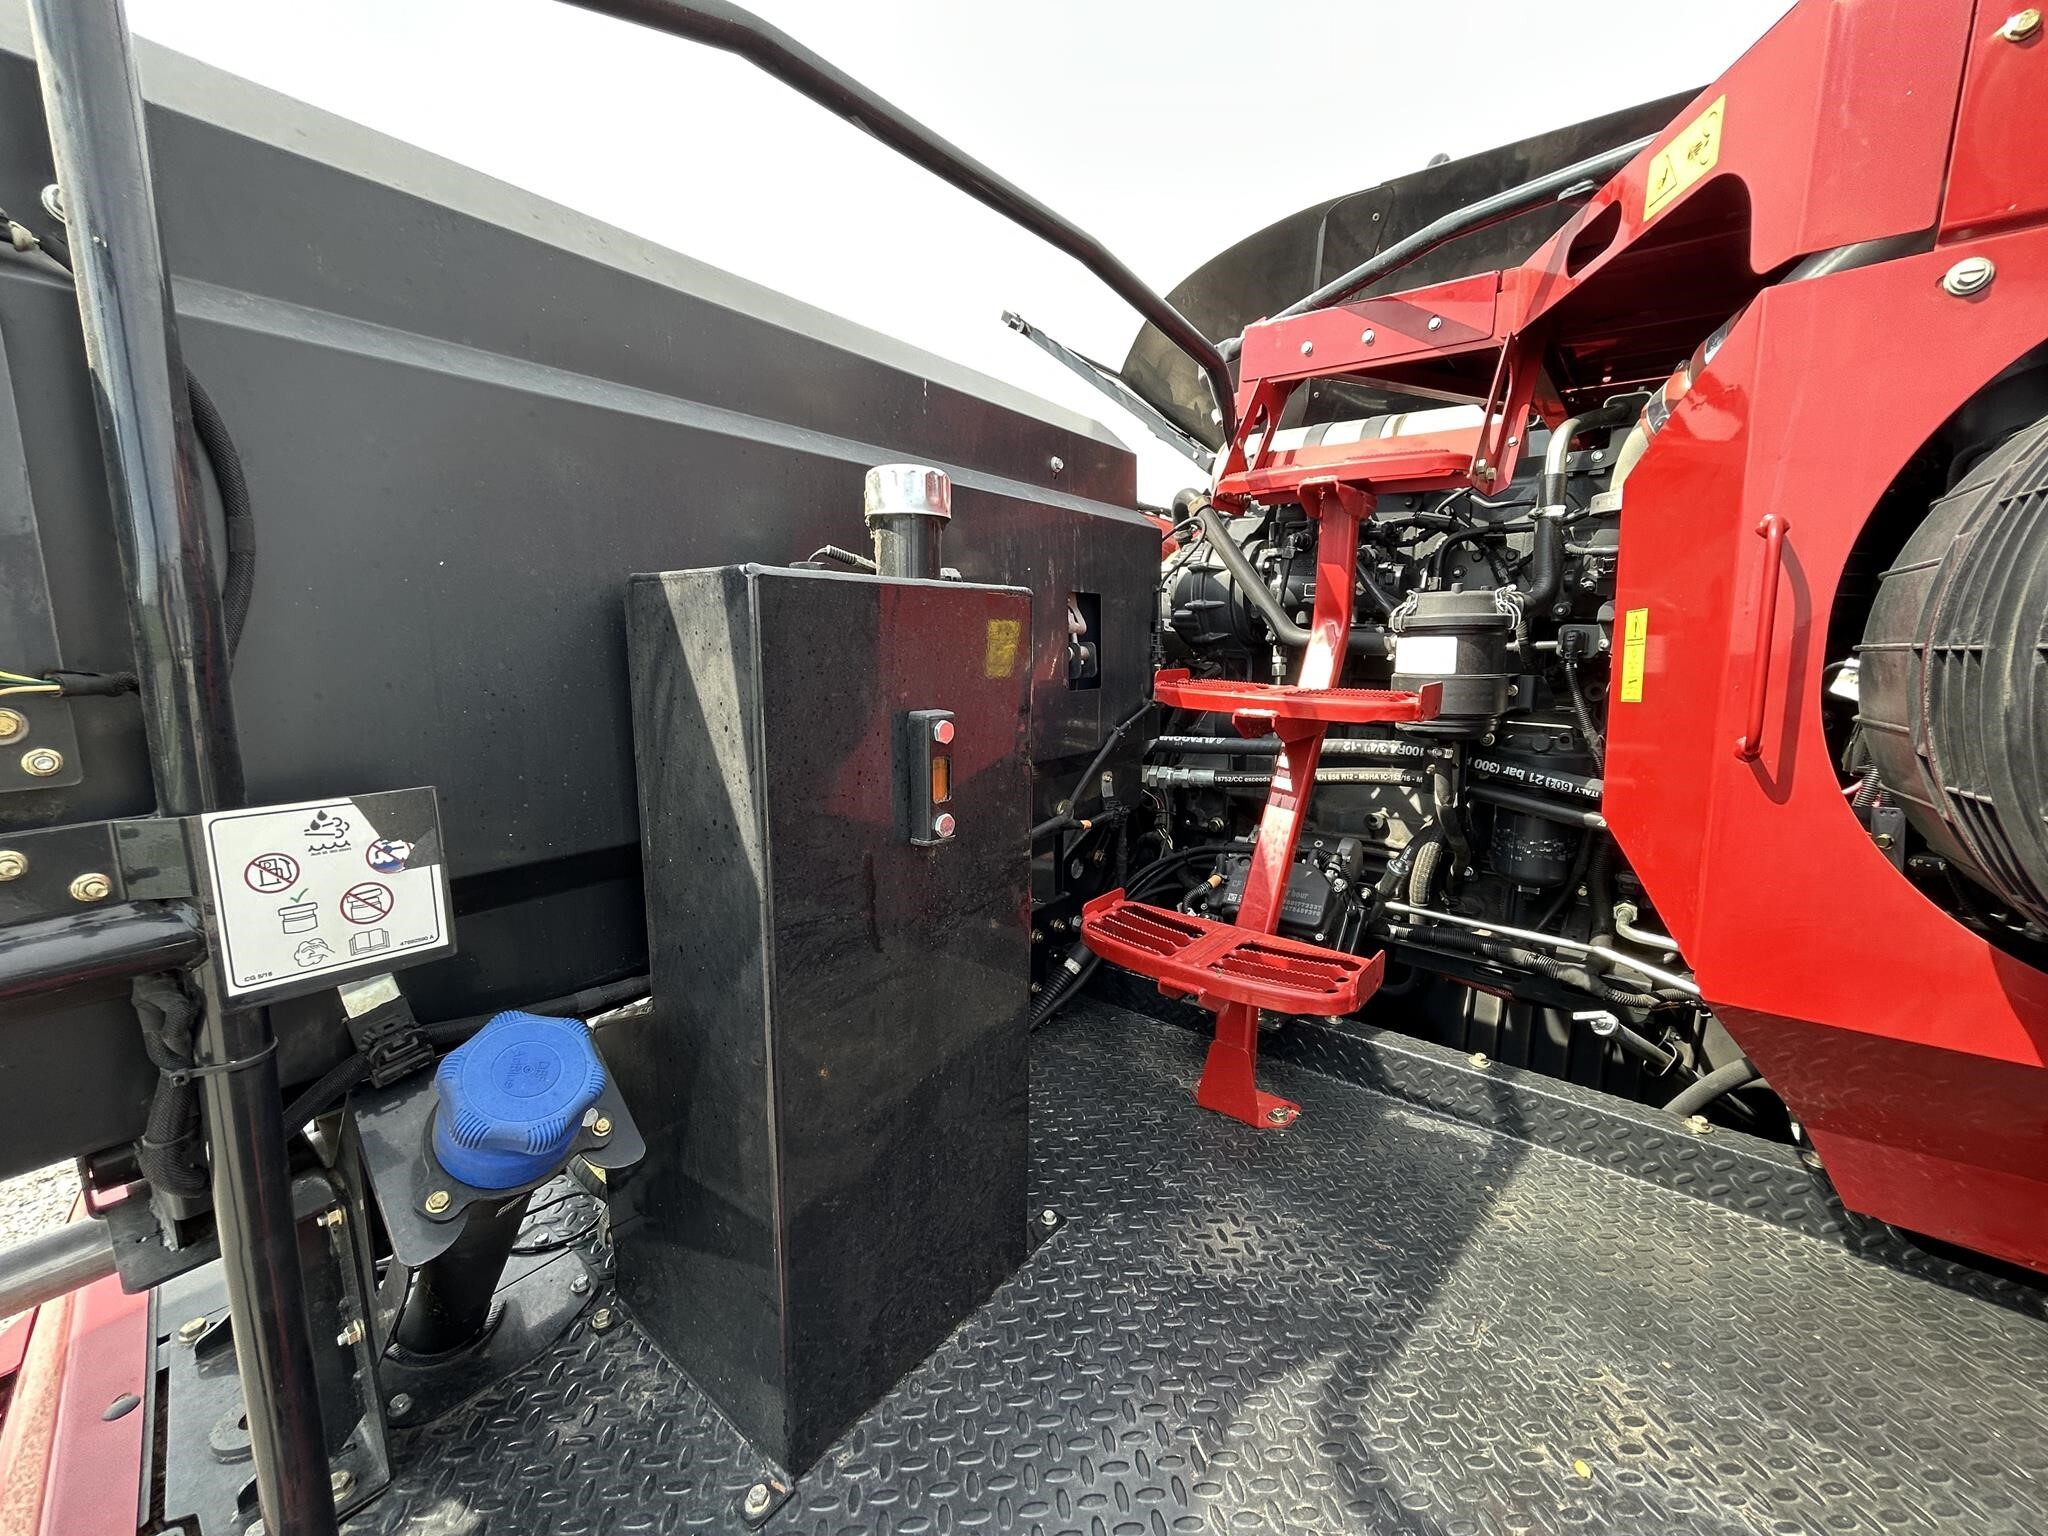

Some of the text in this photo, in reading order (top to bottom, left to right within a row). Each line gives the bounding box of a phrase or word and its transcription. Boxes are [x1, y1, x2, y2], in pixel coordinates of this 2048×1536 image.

[1390, 743, 1425, 757] 100R4
[1474, 758, 1501, 774] (300
[1502, 765, 1526, 781] bar
[1358, 772, 1380, 781] MSHA
[1528, 772, 1545, 786] 21
[1574, 786, 1600, 798] ITALY
